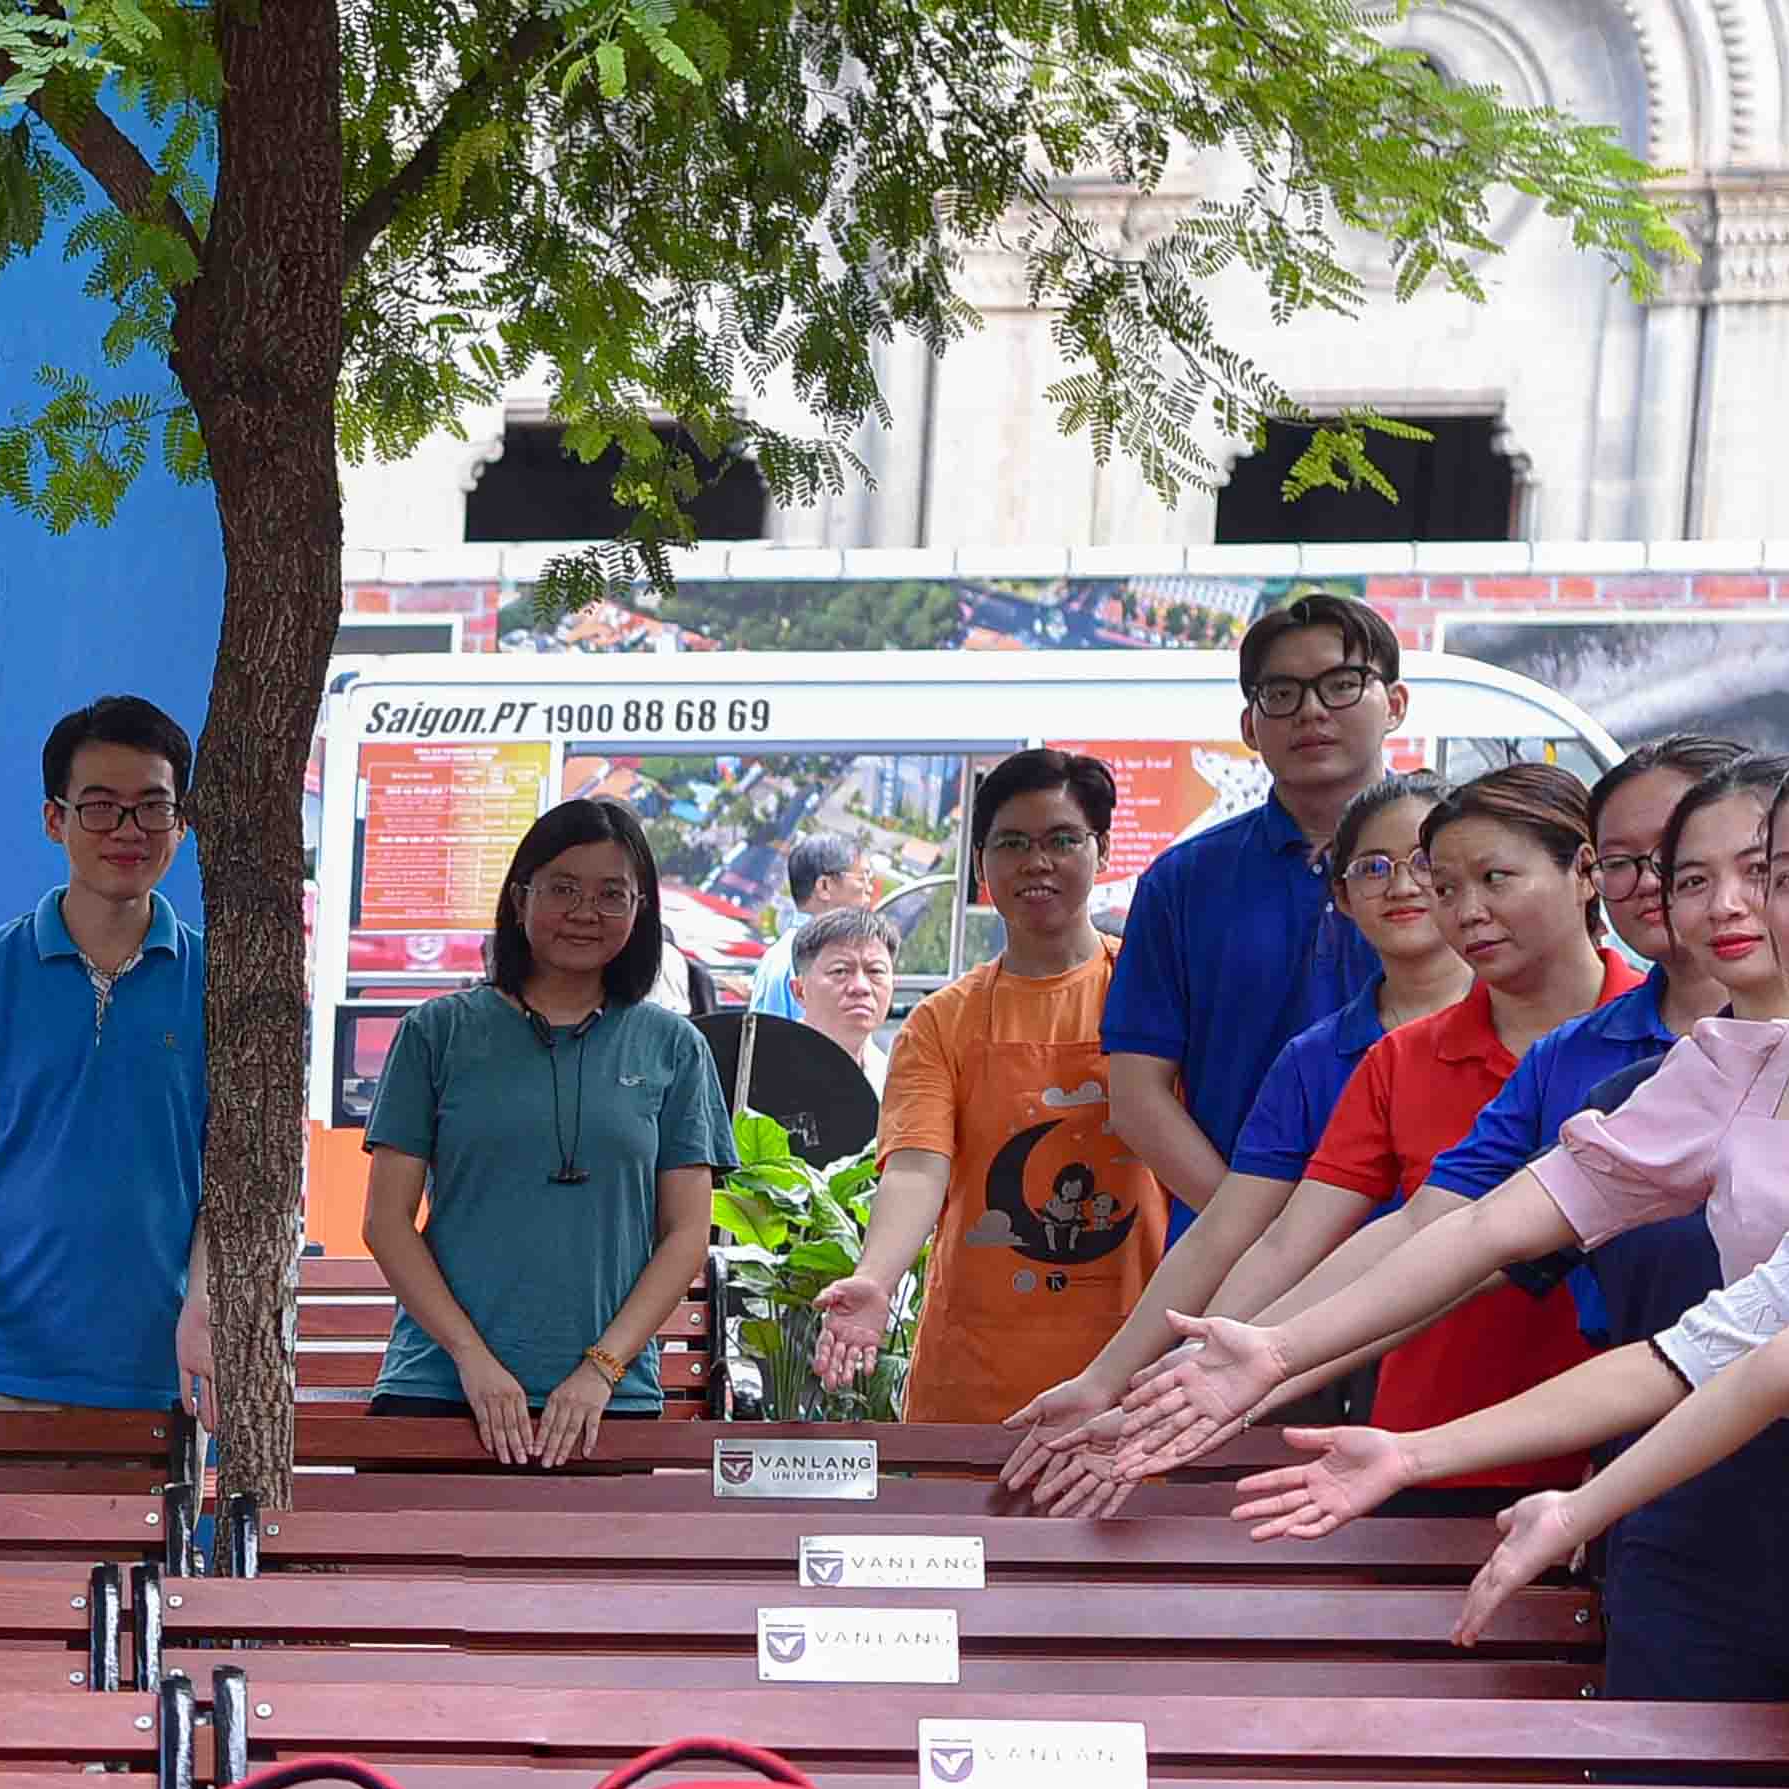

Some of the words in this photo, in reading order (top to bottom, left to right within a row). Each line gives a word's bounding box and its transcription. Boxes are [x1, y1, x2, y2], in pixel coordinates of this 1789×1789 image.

[365, 701, 537, 737] Saigon.PT
[542, 704, 613, 733] 1900
[622, 700, 664, 733] 88
[674, 699, 717, 733] 68
[728, 699, 771, 733] 69
[759, 1455, 872, 1469] VANLANG
[772, 1472, 860, 1481] UNIVERSITY
